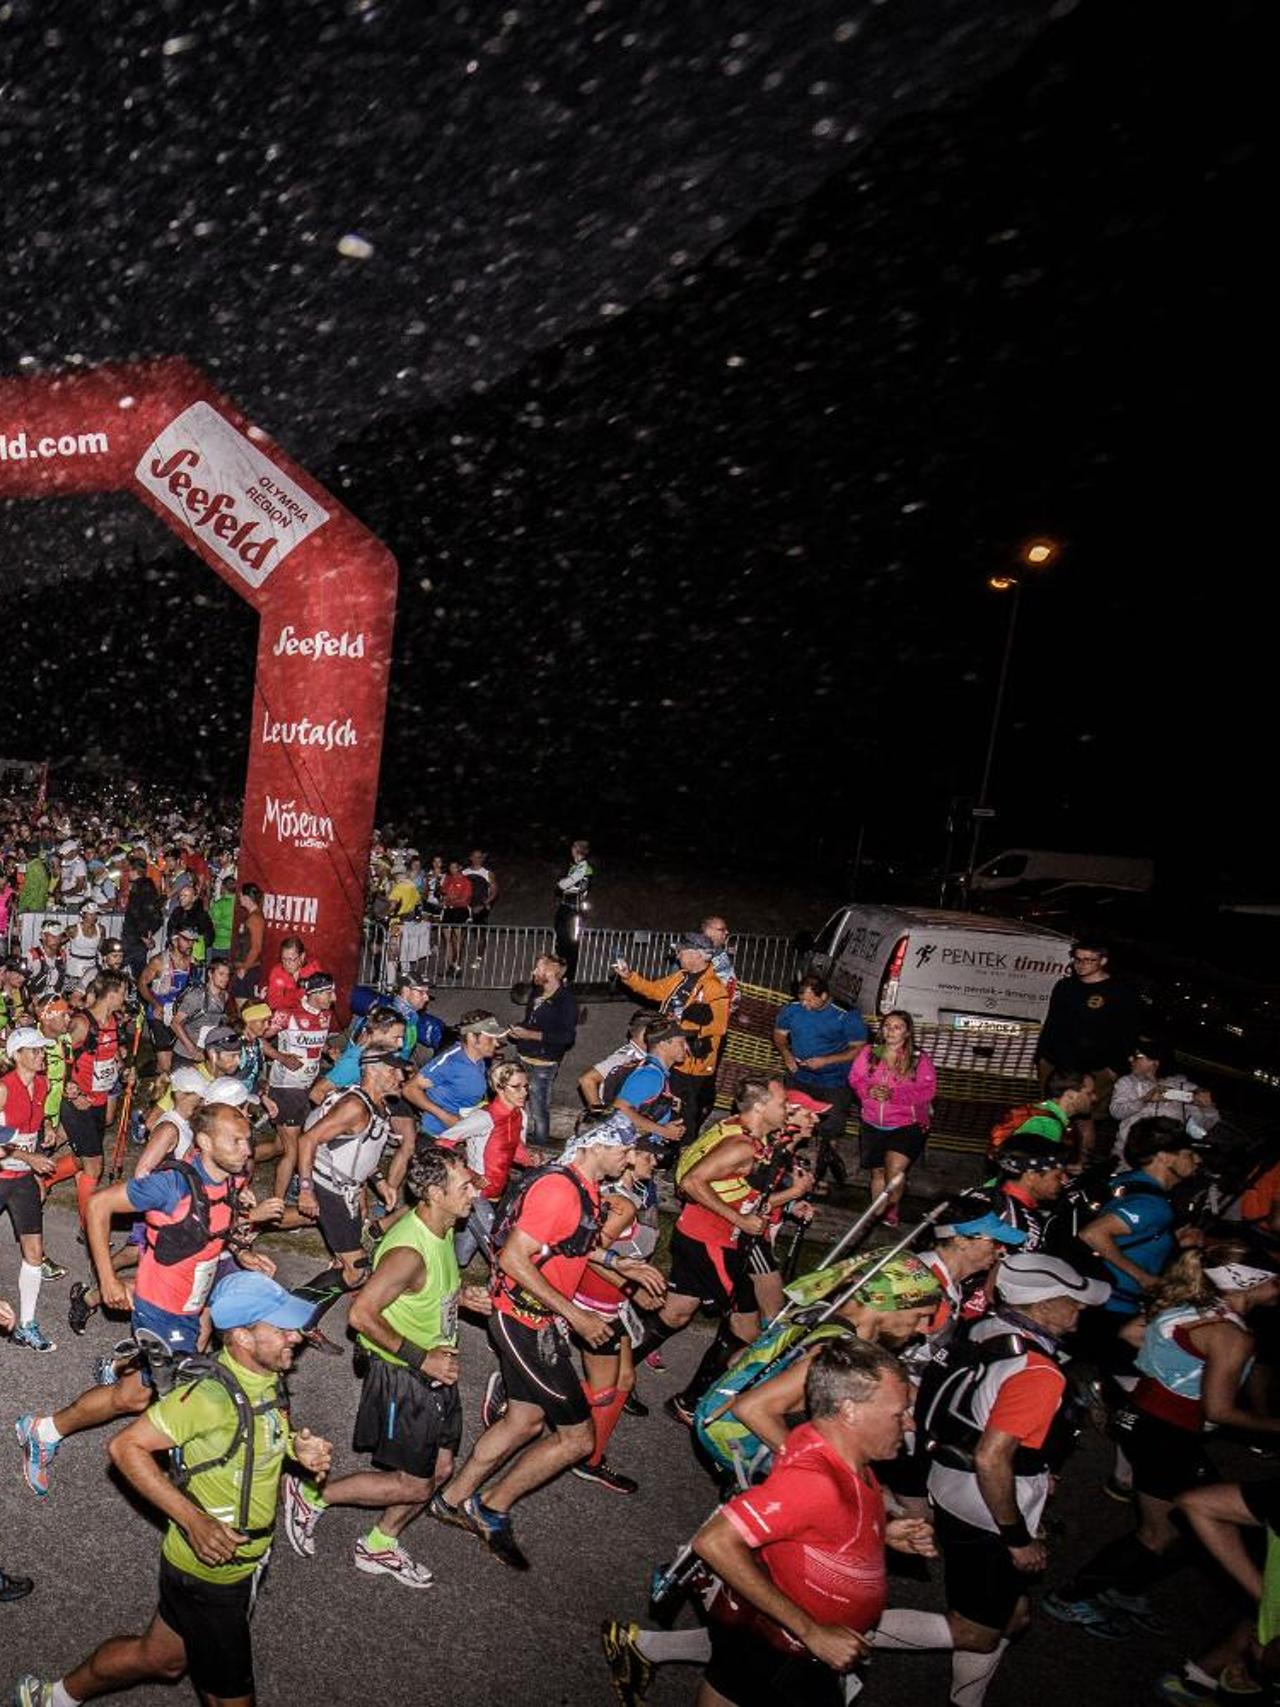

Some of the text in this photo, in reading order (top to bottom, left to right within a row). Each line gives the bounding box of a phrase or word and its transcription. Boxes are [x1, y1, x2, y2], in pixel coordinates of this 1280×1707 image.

[151, 449, 278, 571] Seefeld
[245, 486, 293, 529] REGION
[259, 476, 309, 523] OLYMPIA
[272, 625, 365, 662] Seefeld
[262, 711, 358, 752] Leutasch
[262, 893, 319, 924] REITH
[942, 948, 1008, 968] PENTEK
